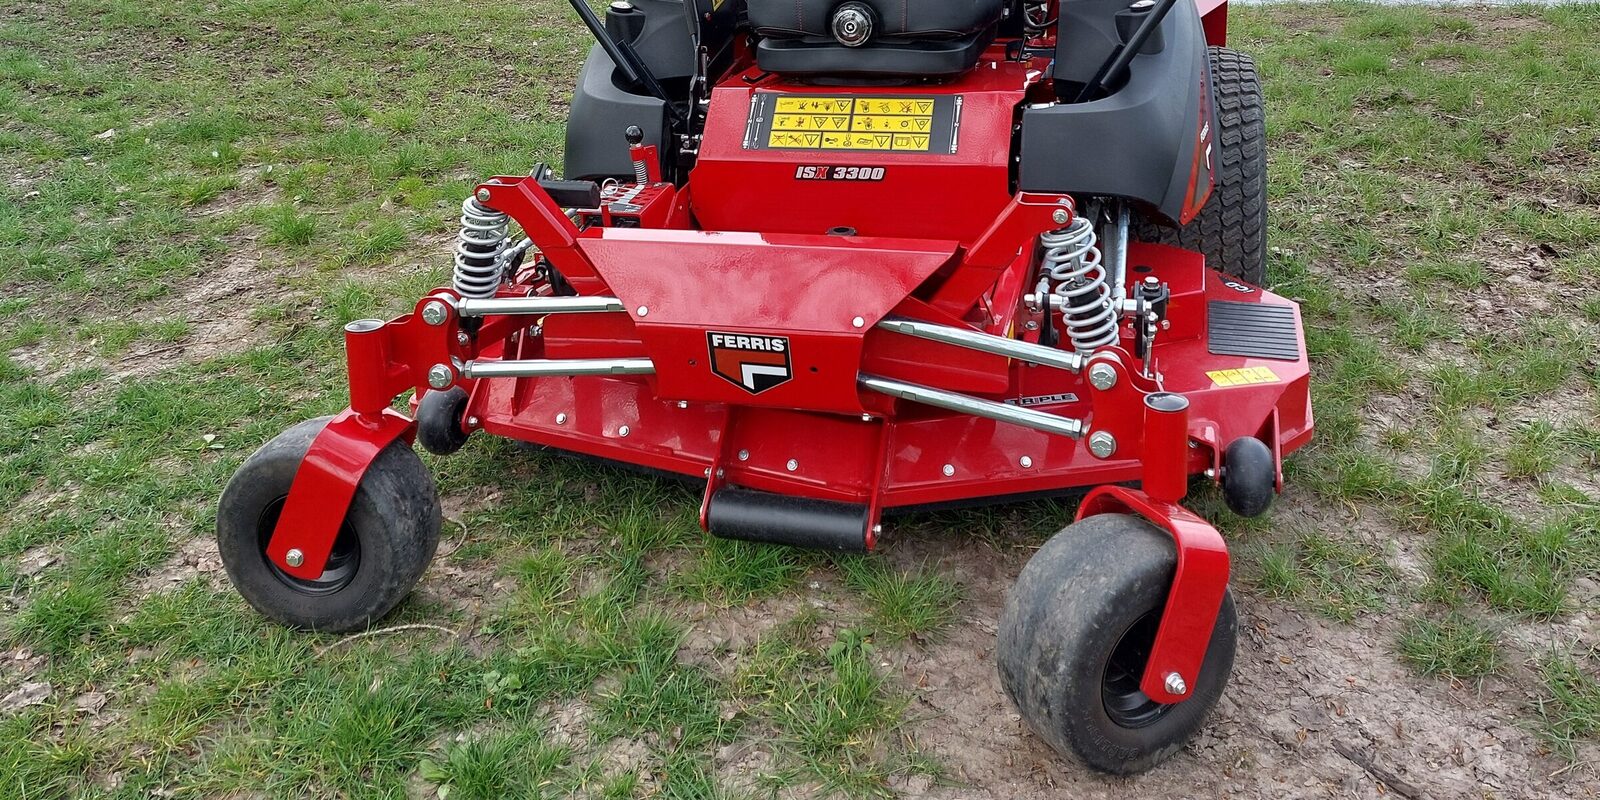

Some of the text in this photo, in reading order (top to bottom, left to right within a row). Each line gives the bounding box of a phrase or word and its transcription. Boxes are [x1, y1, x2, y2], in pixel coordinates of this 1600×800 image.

[795, 166, 885, 180] ISX 3300
[712, 334, 785, 352] FERRIS
